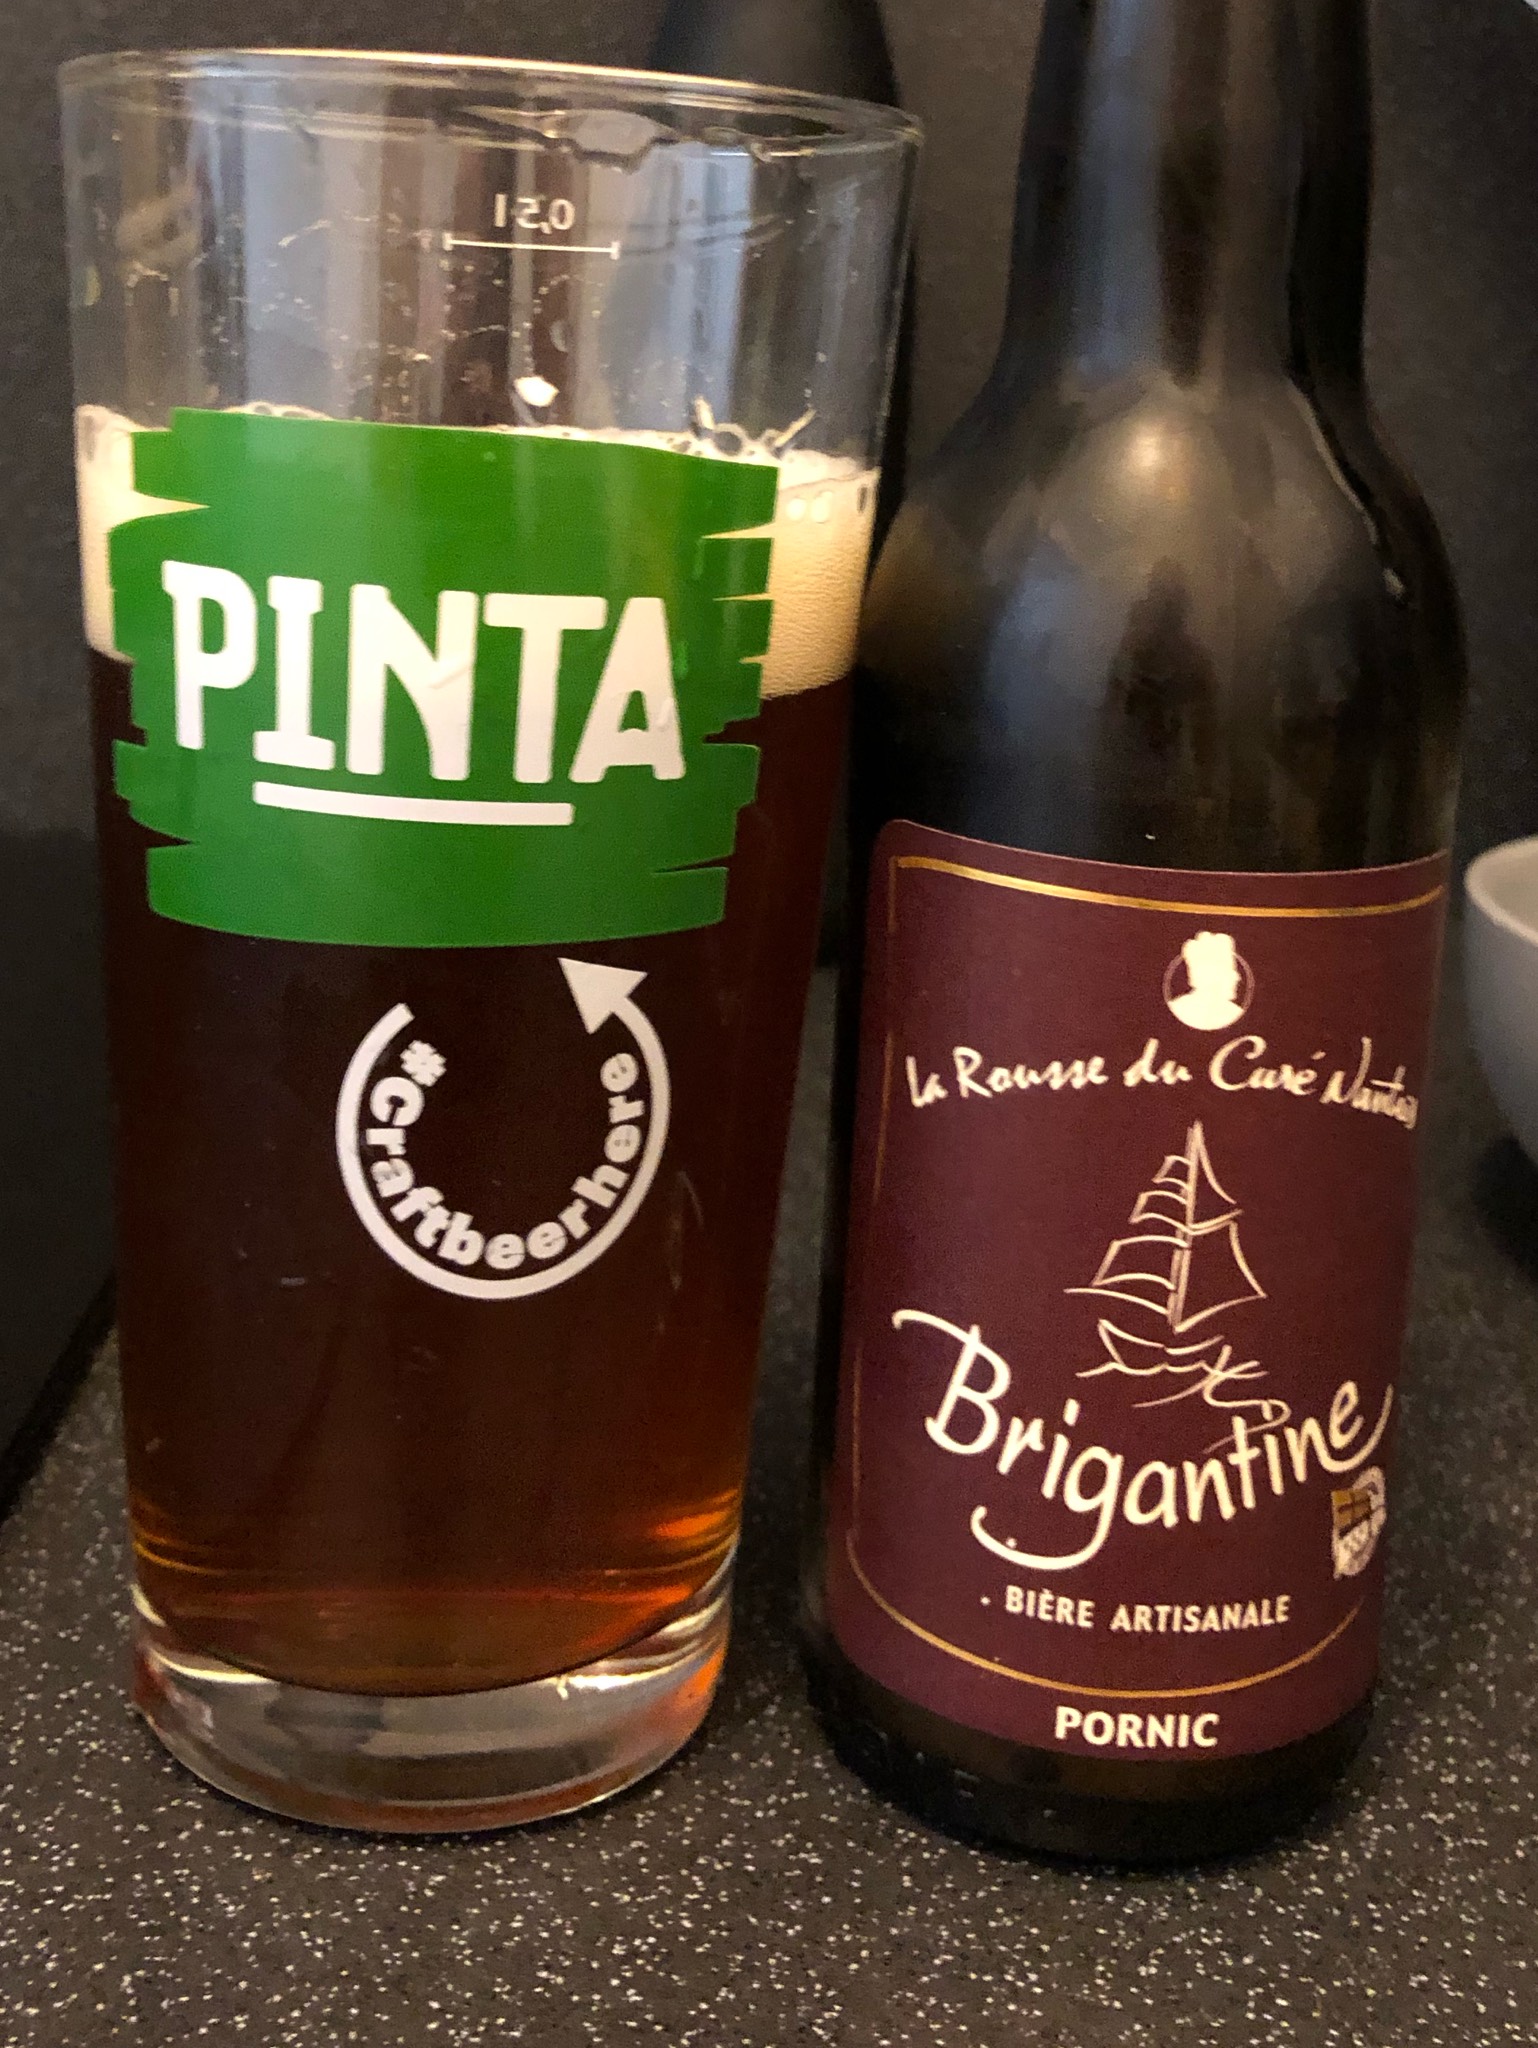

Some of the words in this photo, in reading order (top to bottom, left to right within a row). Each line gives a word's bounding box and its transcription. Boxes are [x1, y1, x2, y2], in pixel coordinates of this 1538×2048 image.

[161, 560, 686, 784] PINTA
[953, 1045, 1110, 1098] Rousse
[1122, 1037, 1193, 1088] du
[1208, 1034, 1326, 1096] Curé
[365, 1040, 645, 1270] #Craftbeerhere
[892, 1308, 1393, 1571] Brigantine
[1004, 1584, 1096, 1629] BIÈRE
[1110, 1594, 1292, 1634] ARTISANALE
[1054, 1705, 1220, 1749] PORNIC
